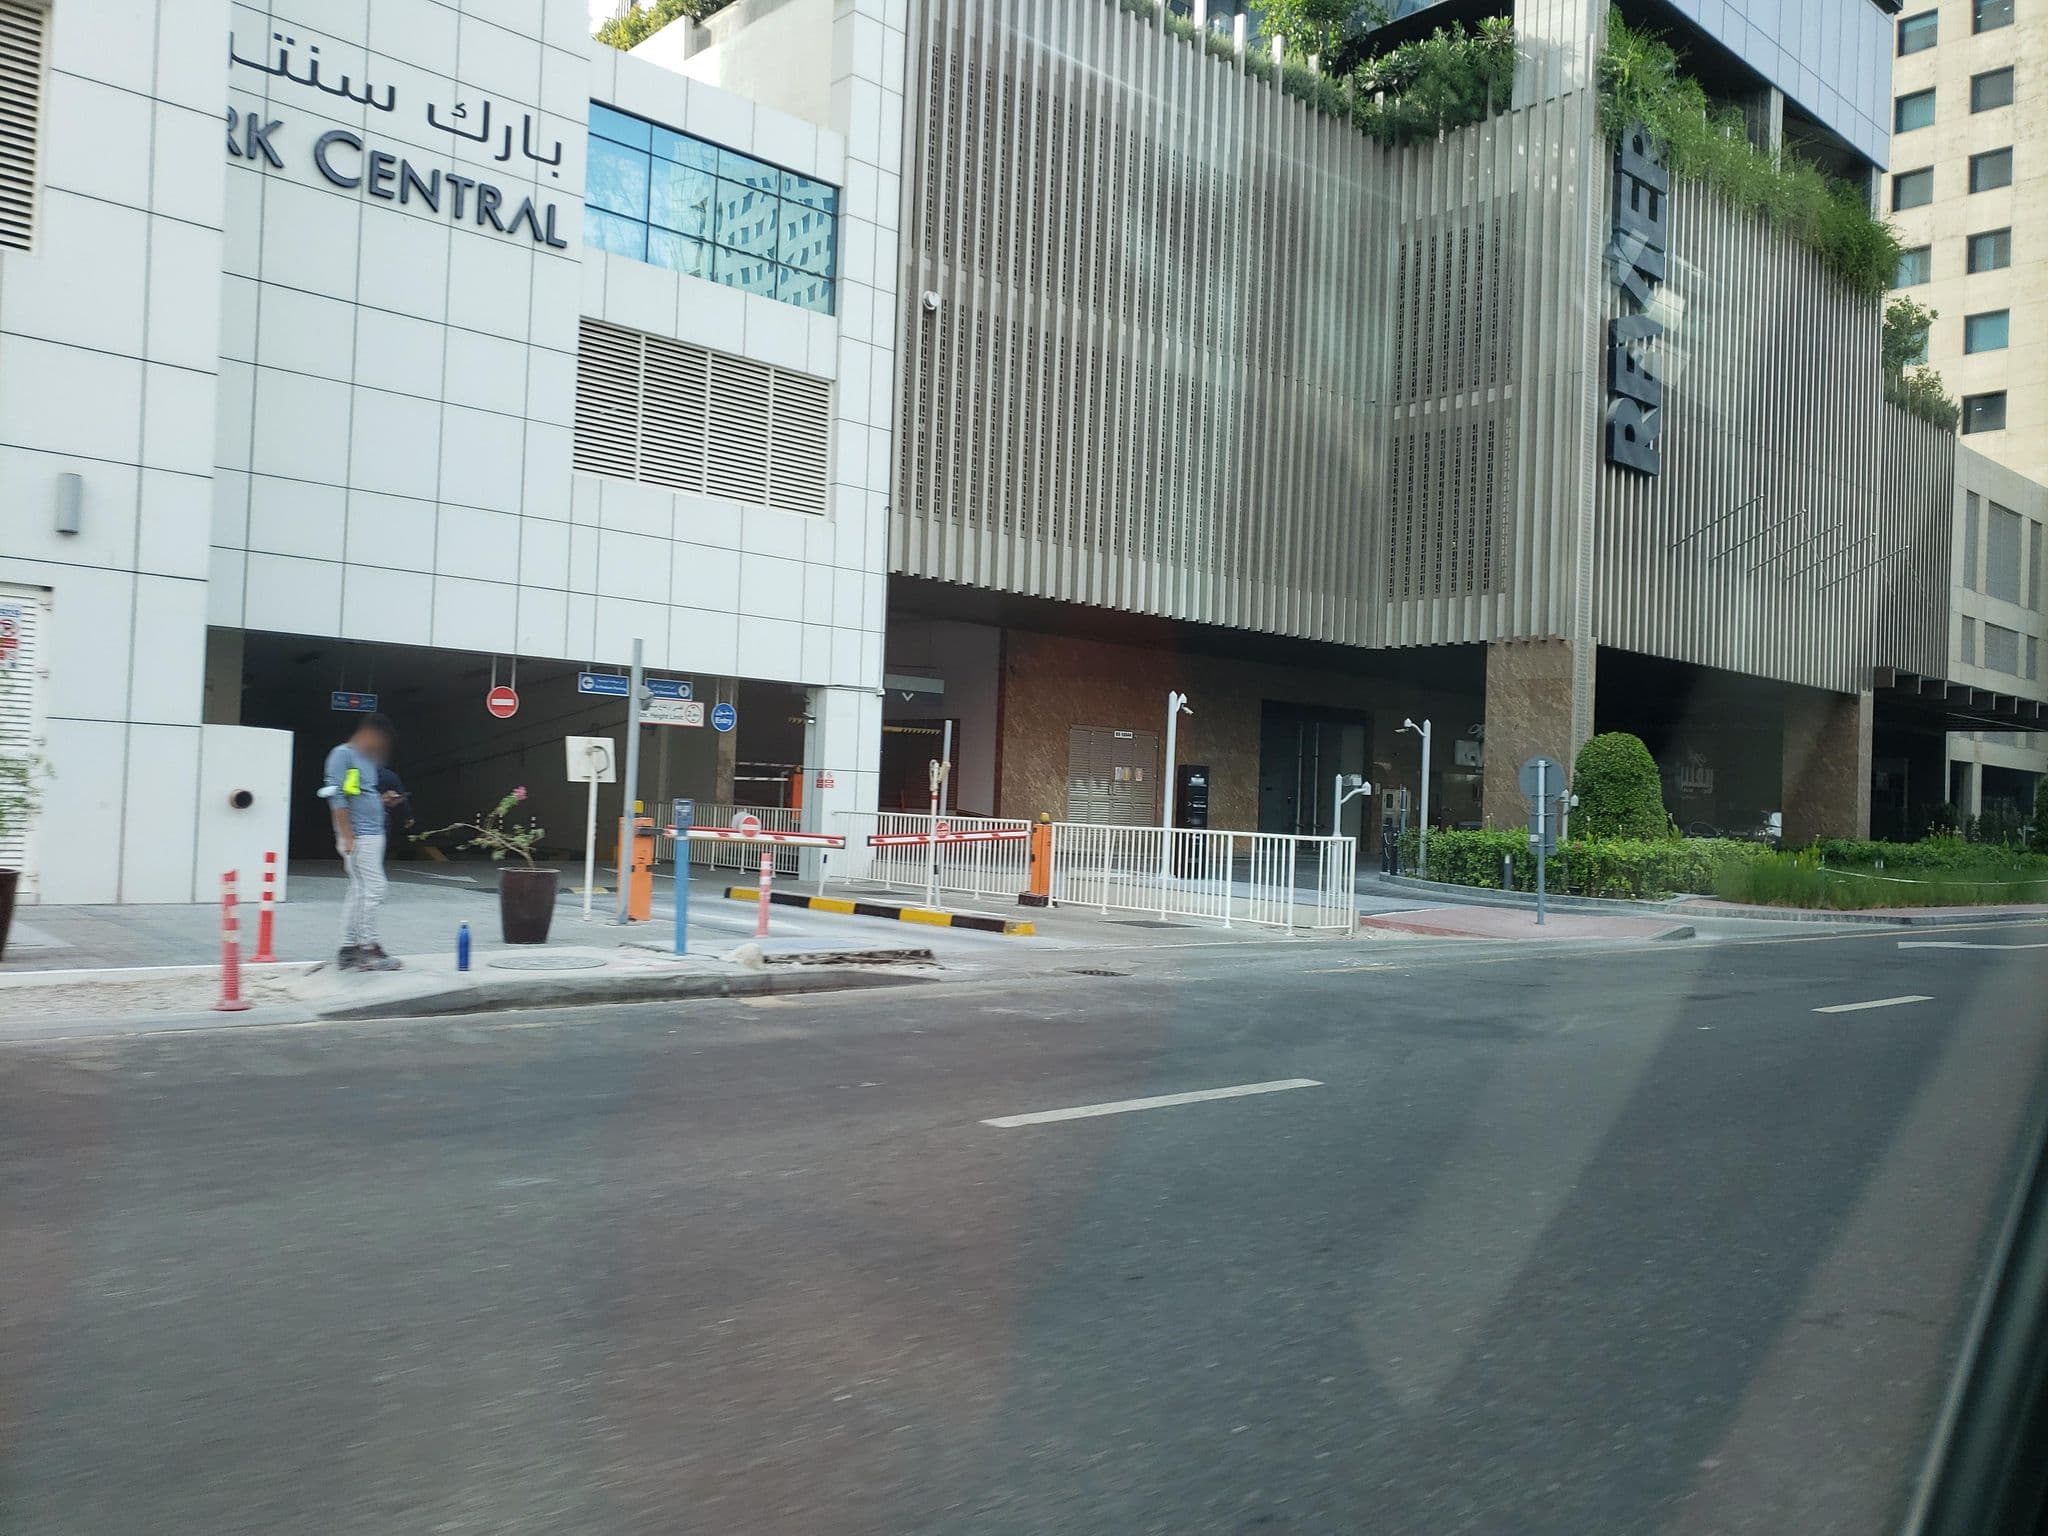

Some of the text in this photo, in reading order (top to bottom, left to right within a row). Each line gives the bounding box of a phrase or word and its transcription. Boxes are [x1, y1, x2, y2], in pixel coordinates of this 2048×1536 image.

[427, 101, 562, 178] بارك
[314, 130, 567, 248] CENTRAL
[1606, 122, 1670, 478] REVIER
[714, 717, 733, 726] Entry
